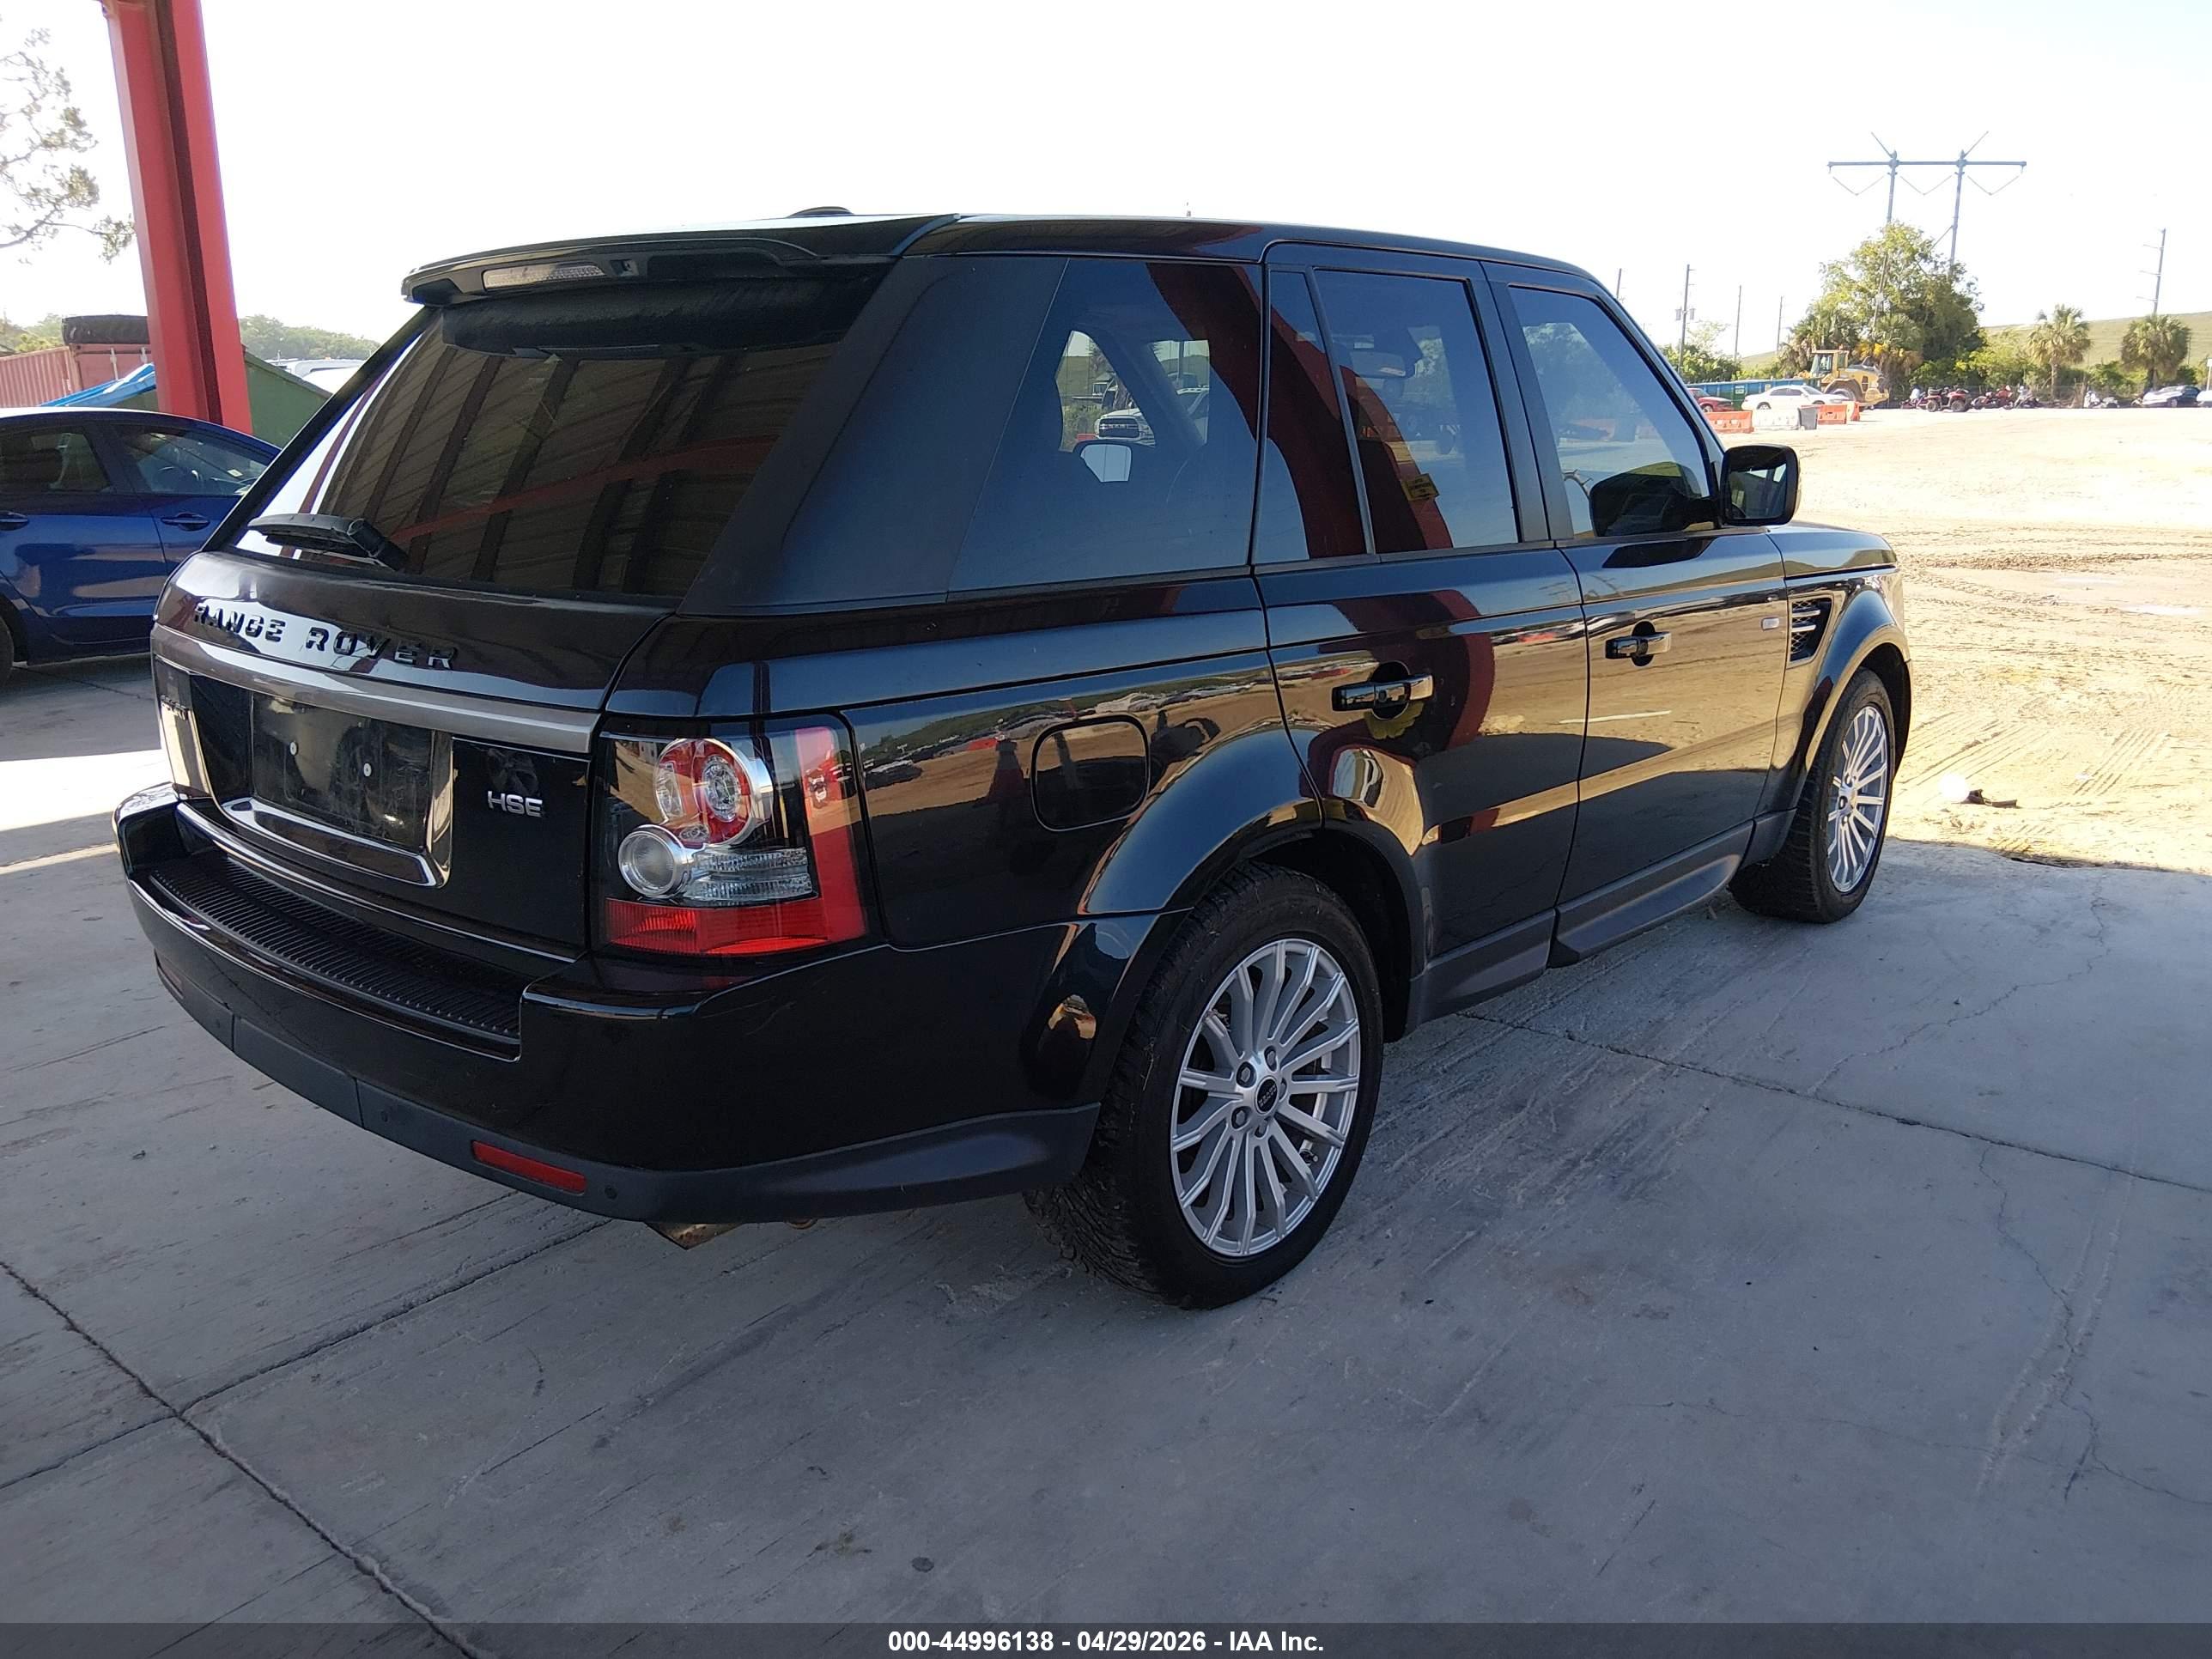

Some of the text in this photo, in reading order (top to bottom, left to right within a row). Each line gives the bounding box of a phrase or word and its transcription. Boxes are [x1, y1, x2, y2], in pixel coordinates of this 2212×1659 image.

[193, 603, 458, 671] RANGE ROVER
[487, 790, 544, 818] HSE
